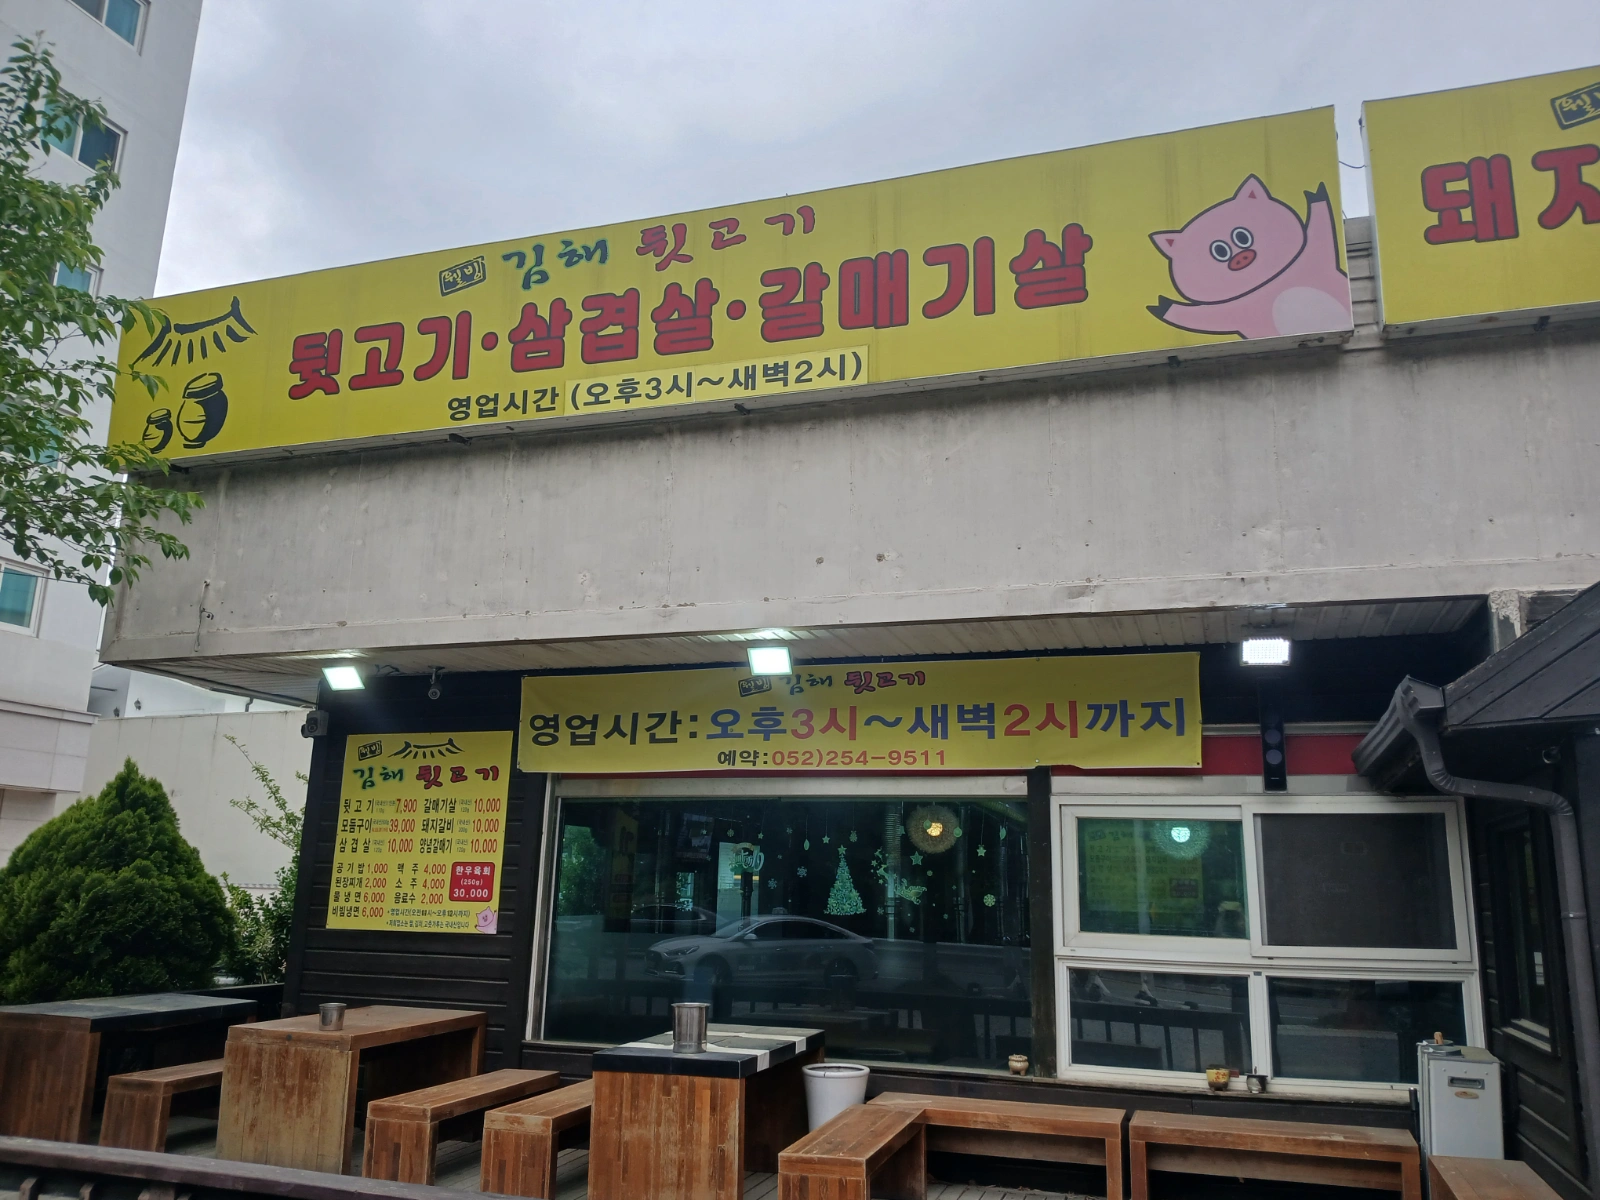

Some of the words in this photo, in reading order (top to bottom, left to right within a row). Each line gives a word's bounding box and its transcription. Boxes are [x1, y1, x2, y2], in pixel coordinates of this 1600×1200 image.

[502, 238, 609, 291] 김해
[636, 205, 816, 271] 뒷고기
[447, 386, 559, 421] 영업시간
[779, 674, 833, 695] 김해
[844, 670, 926, 694] 뒷고기
[352, 765, 404, 790] 김해
[416, 765, 500, 790] 뒷고기
[395, 798, 418, 814] 7,900
[424, 798, 457, 814] 갈매기살
[474, 798, 501, 814] 10,000
[341, 818, 373, 834] 모듬구이
[389, 818, 416, 835] 39,000
[421, 818, 454, 834] 돼지갈비
[472, 818, 499, 835] 10,000
[387, 838, 414, 855] 10,000
[420, 838, 453, 854] 양념갈매기
[367, 863, 388, 875] 1,000
[424, 863, 447, 875] 4,000
[455, 865, 491, 876] 한우육회
[335, 877, 363, 889] 된장찌개
[365, 877, 387, 889] 2,000
[422, 878, 445, 890] 4,000
[460, 878, 484, 886] (250g)
[363, 892, 386, 904] 6,000
[394, 892, 416, 904] 음료수
[421, 893, 444, 905] 2,000
[453, 888, 489, 899] 30,000
[332, 905, 360, 918] 비빔냉면
[361, 906, 384, 918] 6,000
